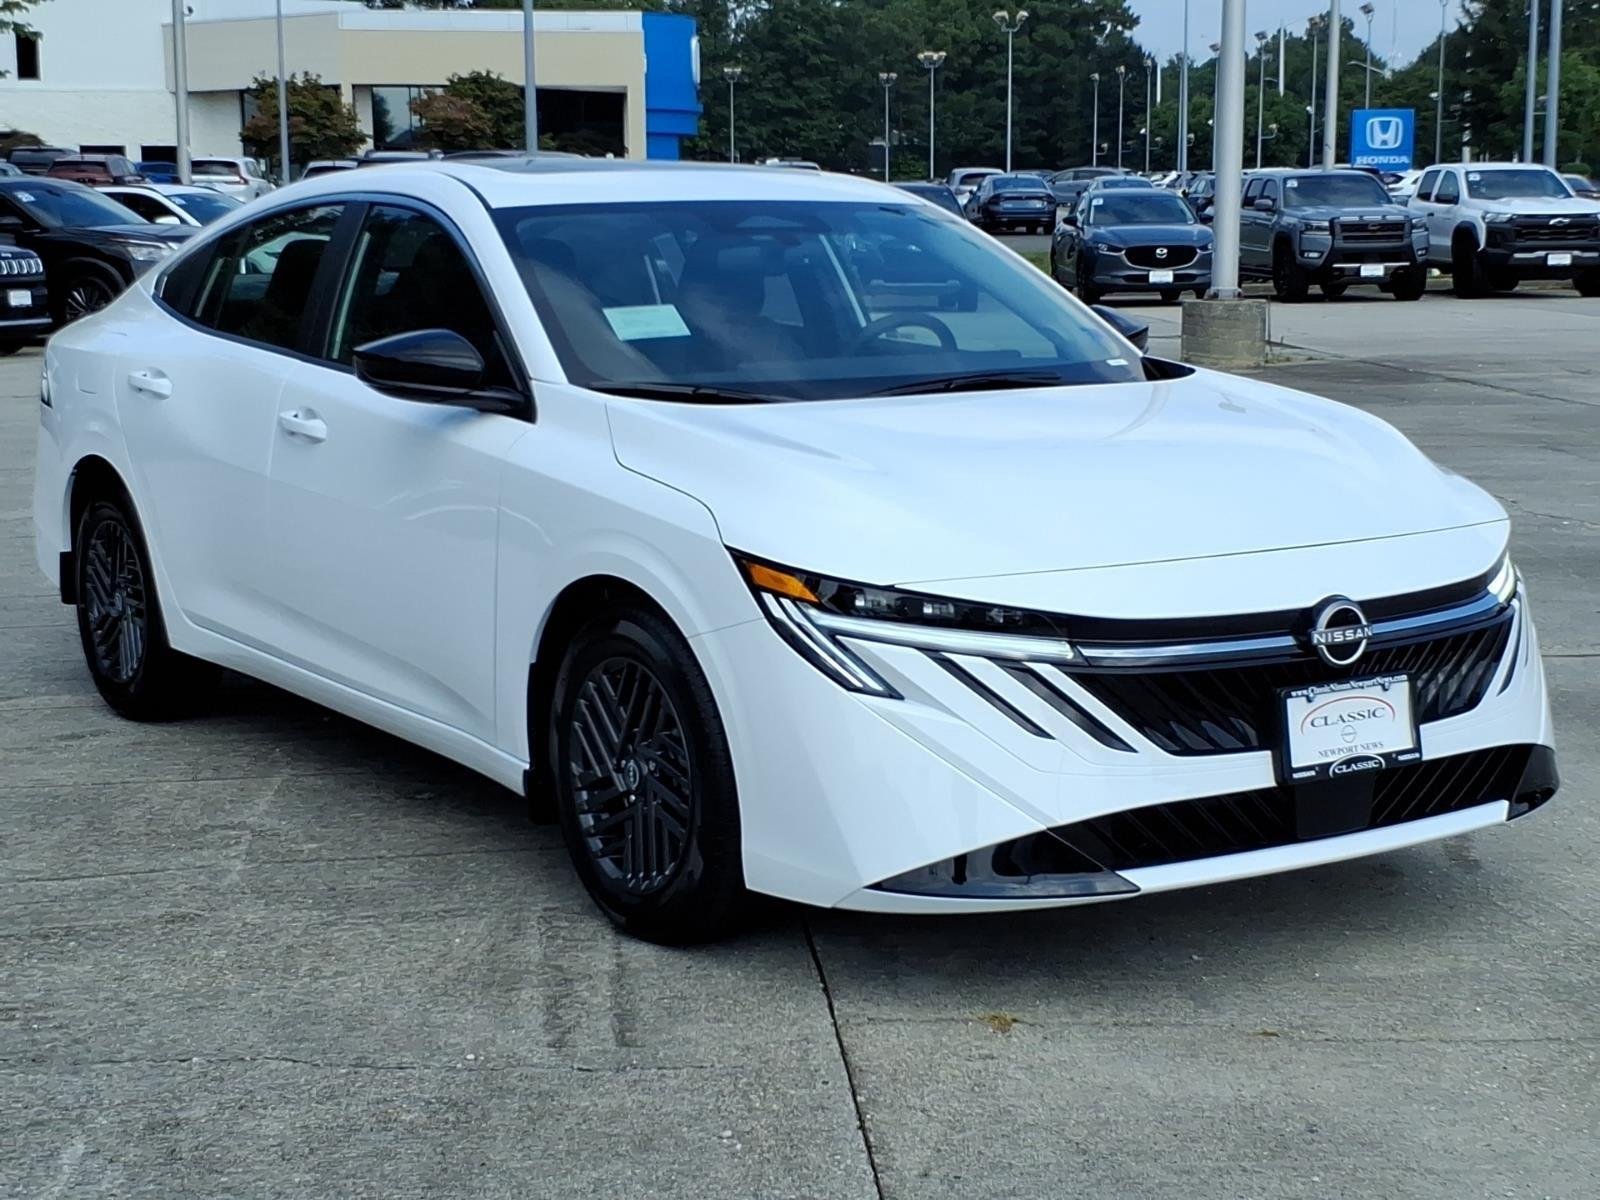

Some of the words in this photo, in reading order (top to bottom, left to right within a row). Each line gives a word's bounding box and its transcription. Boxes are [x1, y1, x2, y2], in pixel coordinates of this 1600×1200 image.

[1355, 155, 1410, 164] HONDA
[1313, 627, 1373, 644] NISSAN
[1310, 706, 1385, 728] CLASSIC
[1318, 745, 1358, 758] NEWPORT
[1359, 742, 1384, 753] NEWS
[1334, 759, 1380, 774] CLASSIC
